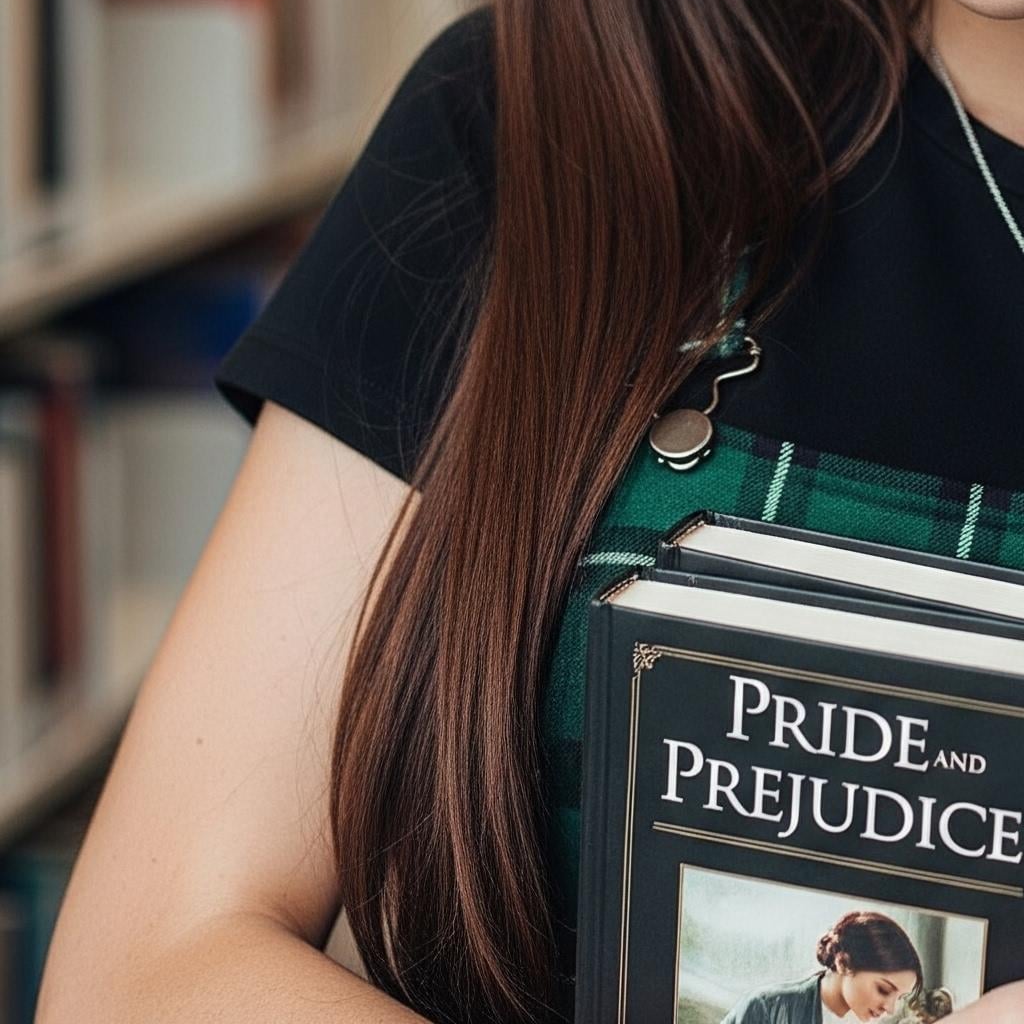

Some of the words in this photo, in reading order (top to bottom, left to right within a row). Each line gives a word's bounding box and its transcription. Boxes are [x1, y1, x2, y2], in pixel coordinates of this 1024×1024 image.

[726, 675, 929, 772] PRIDE
[932, 750, 986, 774] AND
[660, 738, 1024, 864] PREJUDICE
